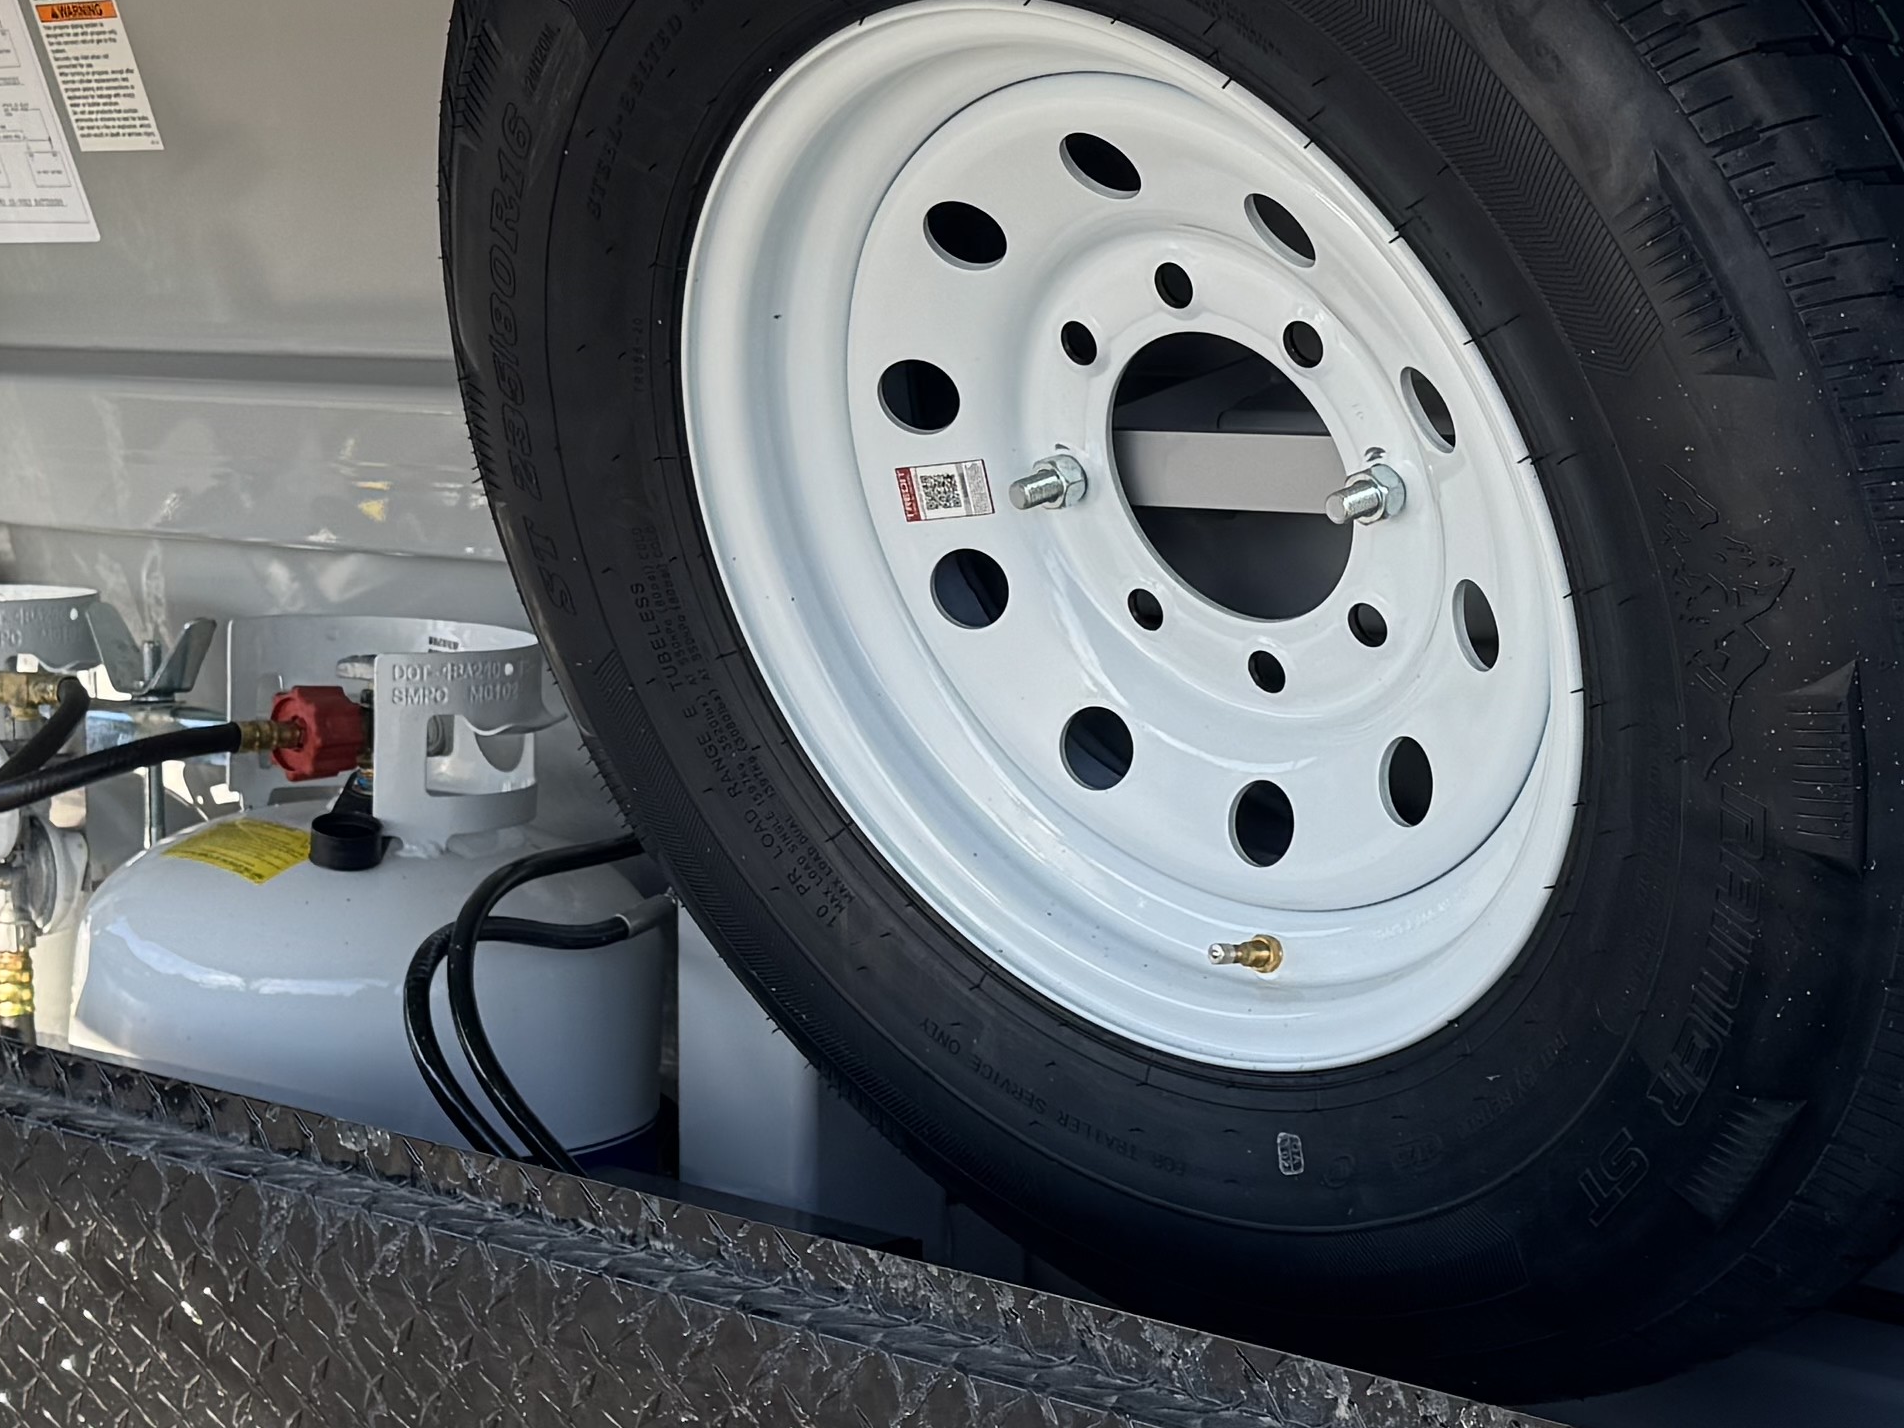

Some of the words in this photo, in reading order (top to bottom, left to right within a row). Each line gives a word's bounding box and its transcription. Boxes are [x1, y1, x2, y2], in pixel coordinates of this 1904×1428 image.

[59, 3, 103, 19] WARNING
[488, 101, 543, 502] 235/80R16
[522, 514, 579, 616] ST
[630, 582, 684, 693] TUBELESS
[682, 704, 698, 719] E
[696, 731, 743, 799] RANGE
[744, 808, 785, 860] LOAD
[765, 810, 799, 854] SINGLE
[787, 867, 812, 896] PR
[797, 855, 824, 887] LOAD
[816, 904, 837, 928] 10
[823, 886, 846, 914] MAX
[1645, 780, 1768, 1127] RAINIER
[919, 1016, 962, 1056] ONLY
[967, 1054, 1048, 1116] SERVICE
[1056, 1108, 1140, 1162] TRAILER
[1577, 1126, 1650, 1229] ST
